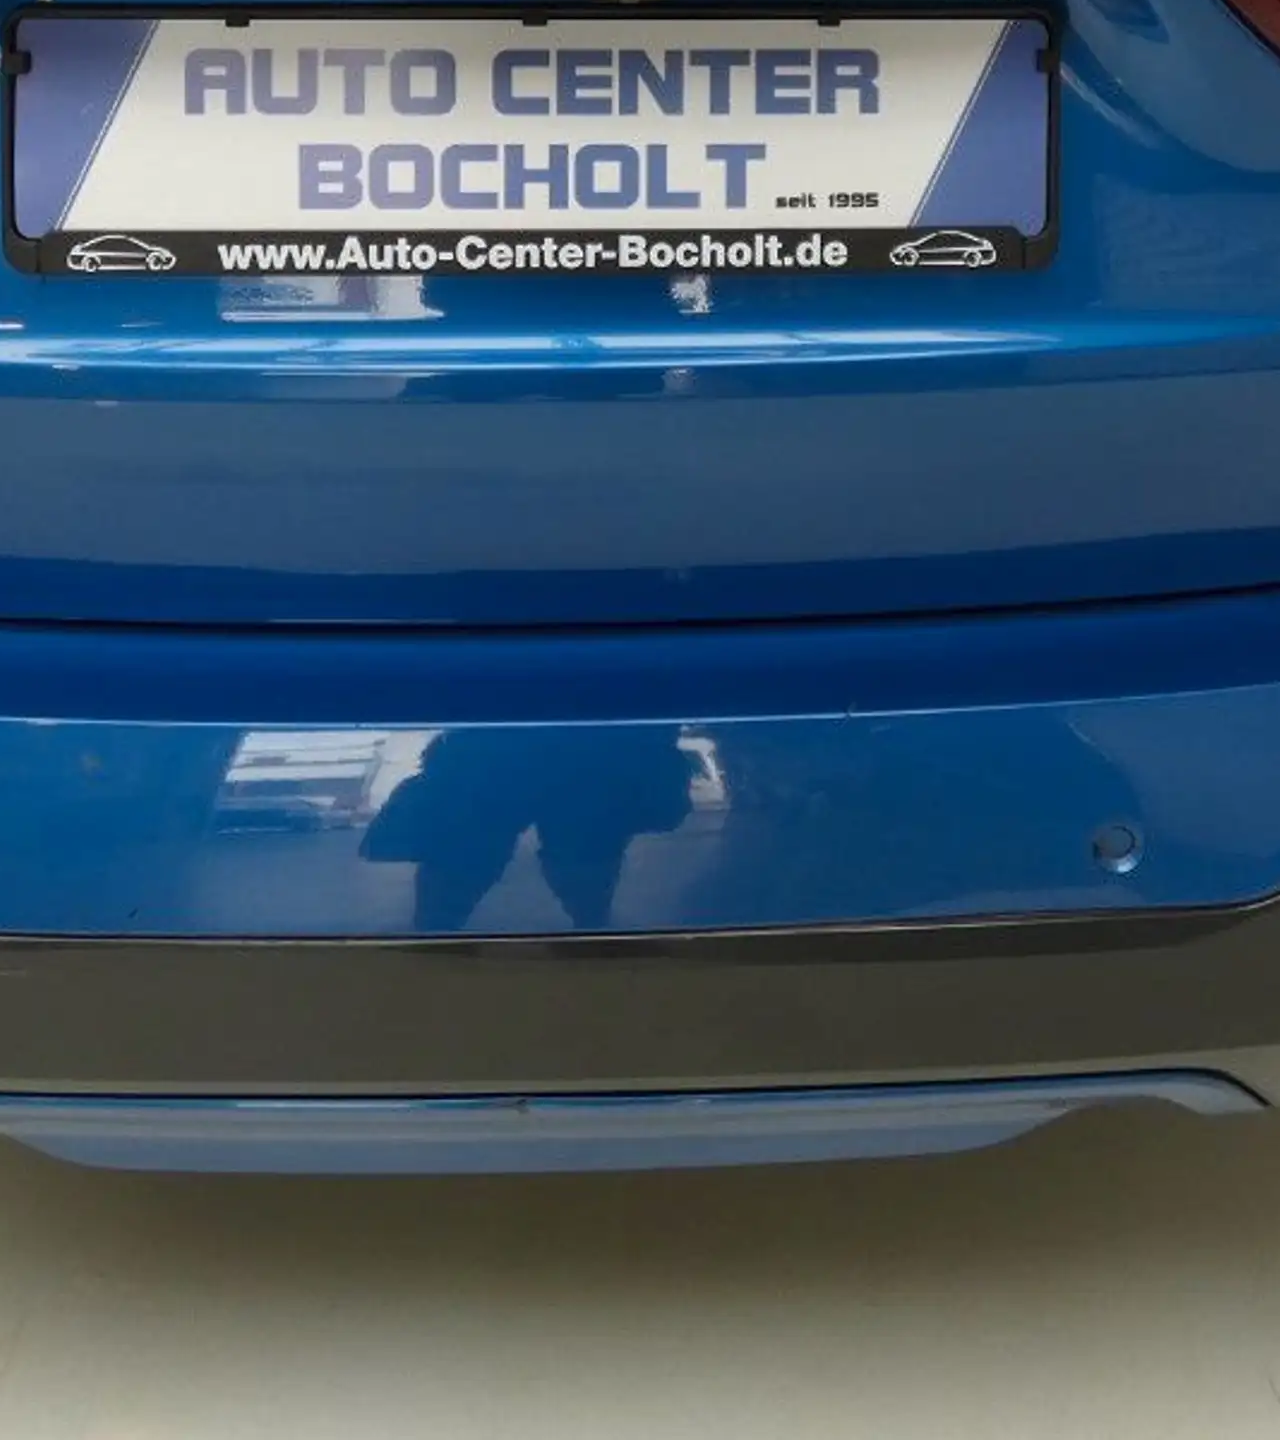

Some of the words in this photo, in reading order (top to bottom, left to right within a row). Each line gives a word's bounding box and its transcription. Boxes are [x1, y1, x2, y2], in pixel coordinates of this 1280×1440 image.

[184, 48, 456, 116] AUTO
[491, 48, 880, 116] CENTER
[298, 143, 767, 211] BOCHOLT
[775, 192, 817, 209] seit
[827, 191, 880, 209] 1995
[217, 233, 848, 271] www.Auto-Center-Bocholt.de
